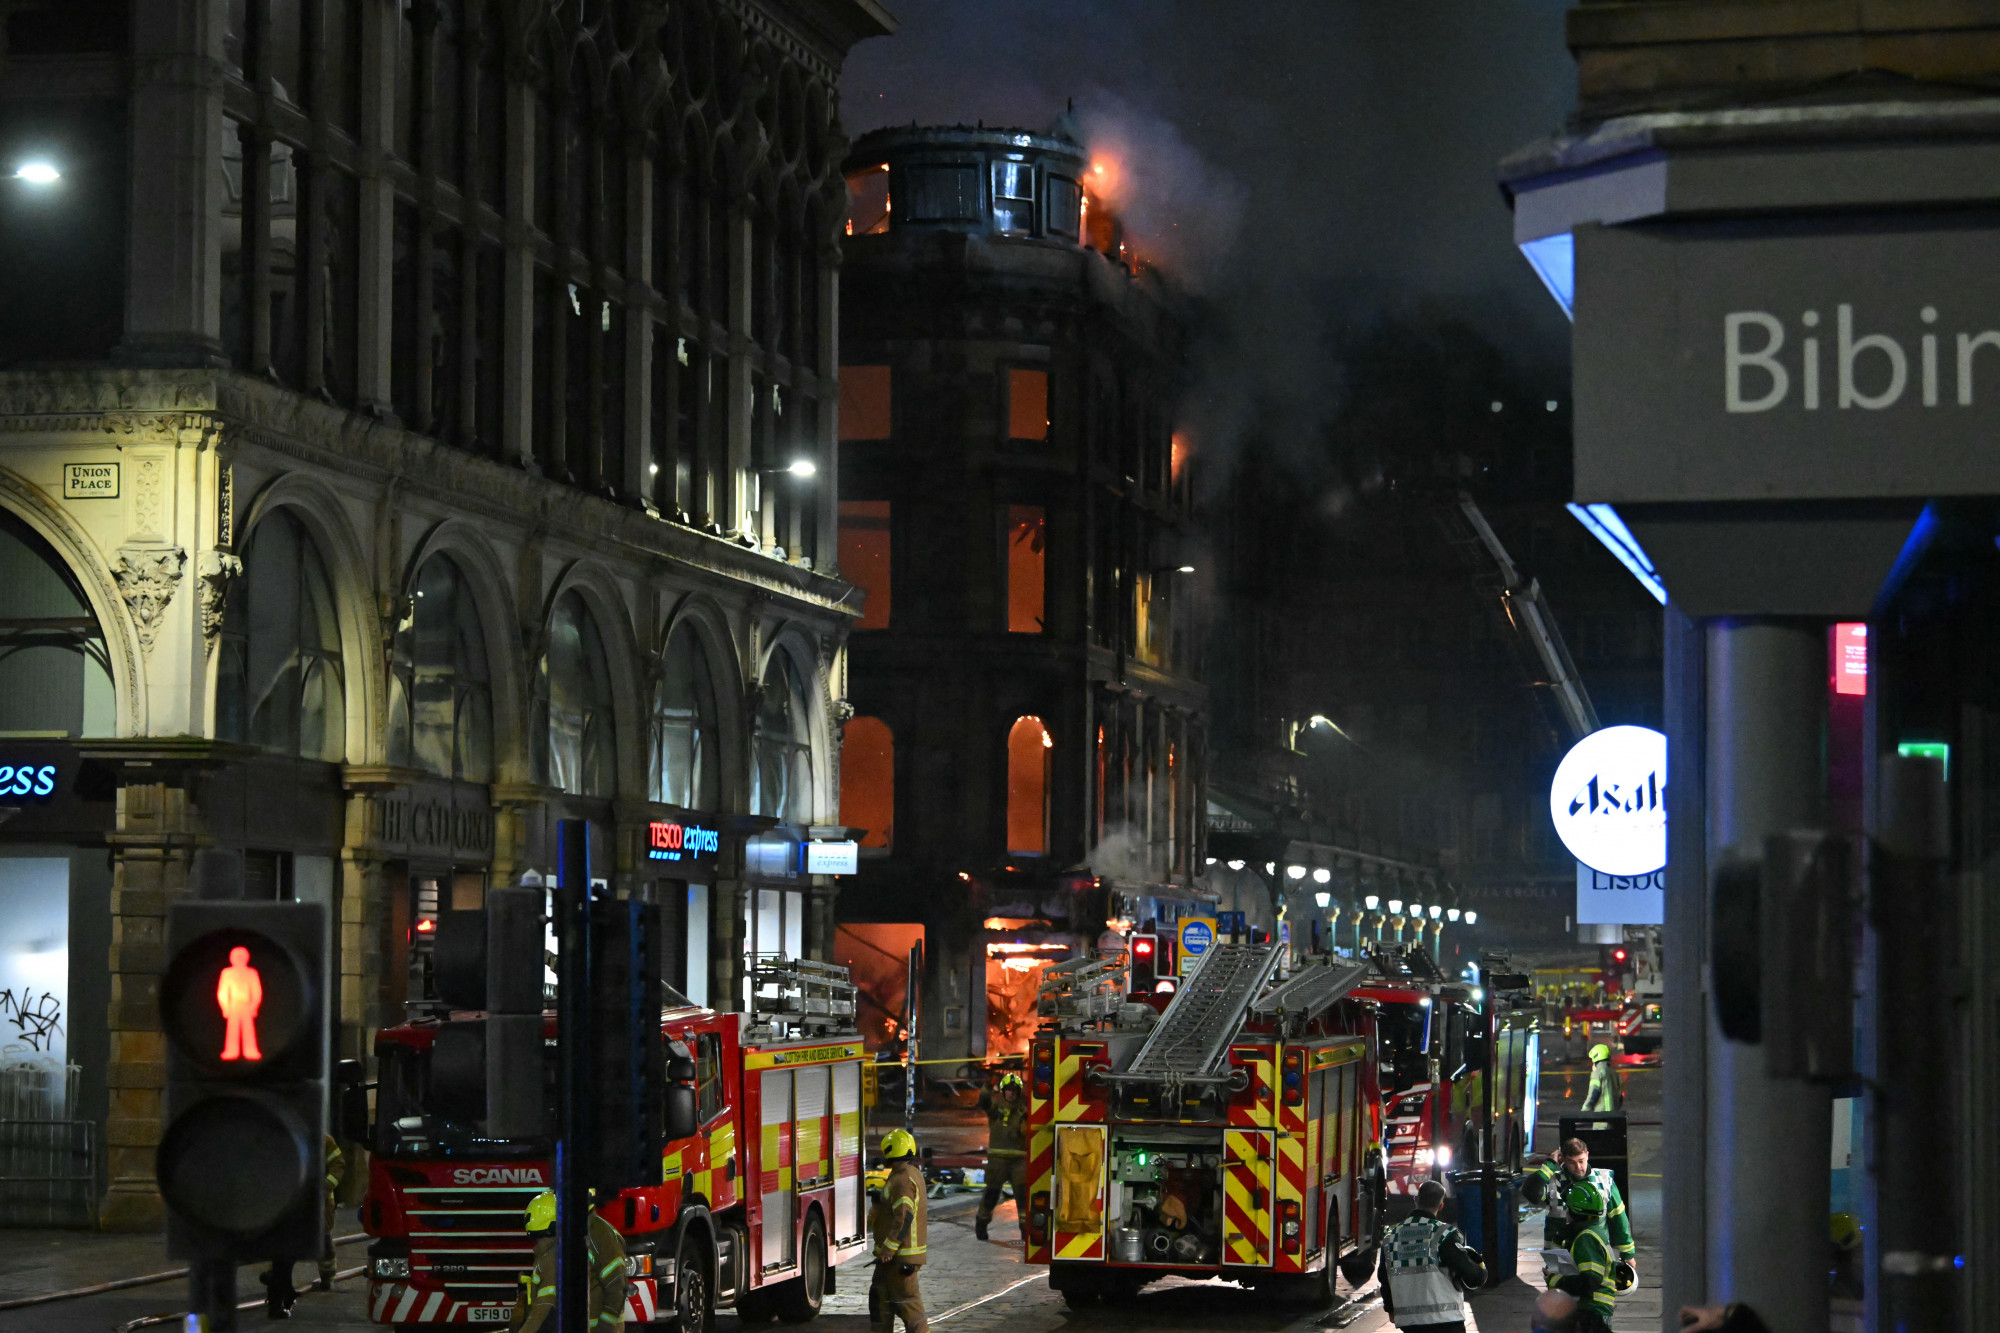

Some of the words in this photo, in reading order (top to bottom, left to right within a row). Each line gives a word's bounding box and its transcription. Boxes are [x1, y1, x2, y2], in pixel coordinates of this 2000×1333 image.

[72, 467, 111, 478] UNION
[71, 479, 112, 489] PLACE
[0, 765, 56, 796] ess
[649, 822, 682, 849] TESCO
[683, 824, 719, 859] express
[809, 1049, 817, 1062] AND
[453, 1168, 544, 1185] SCANIA
[474, 1308, 500, 1320] SF19
